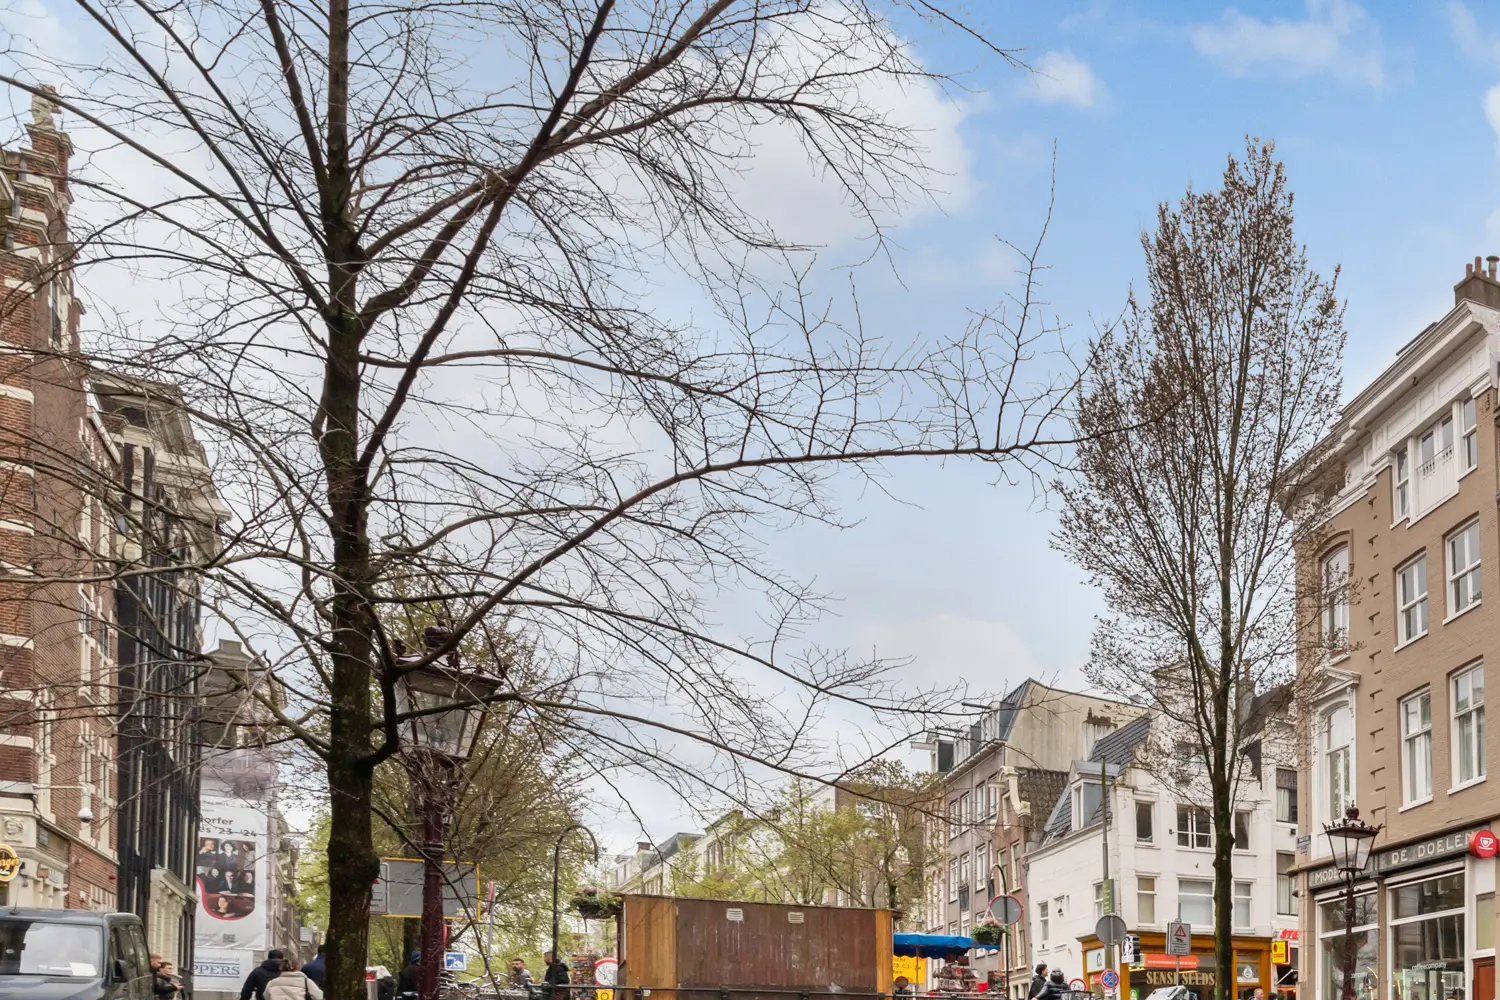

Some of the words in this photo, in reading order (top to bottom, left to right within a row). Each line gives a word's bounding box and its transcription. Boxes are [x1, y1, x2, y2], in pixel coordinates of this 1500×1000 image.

[1392, 849, 1408, 865] DE
[1417, 832, 1473, 857] DOELEN
[1181, 973, 1215, 985] SEEDS
